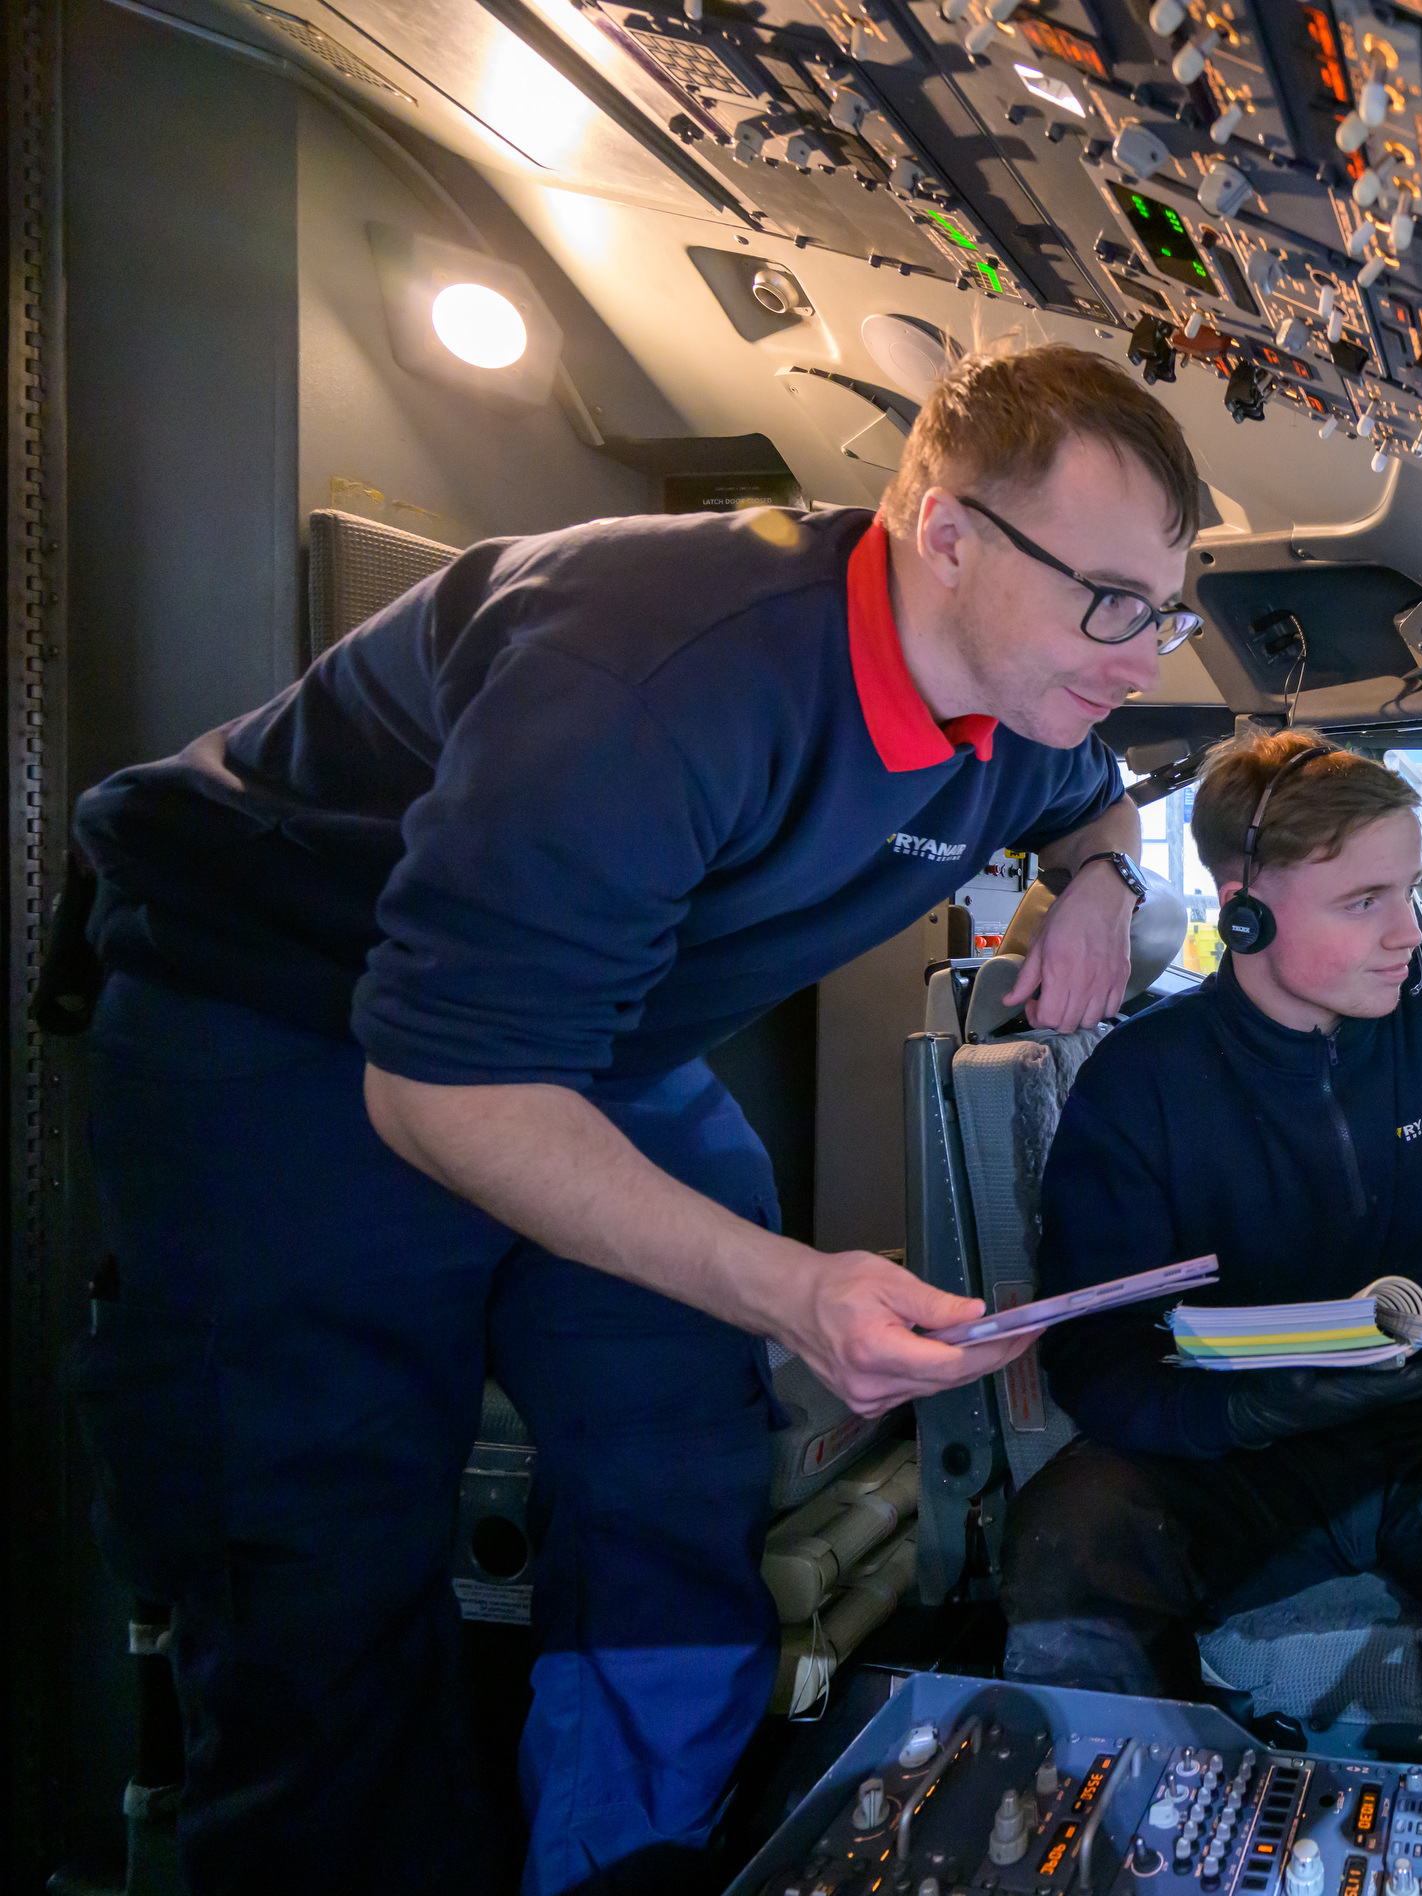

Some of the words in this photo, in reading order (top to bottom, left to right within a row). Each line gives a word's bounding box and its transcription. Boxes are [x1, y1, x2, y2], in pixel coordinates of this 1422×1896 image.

[703, 498, 724, 506] LATCH
[725, 497, 744, 505] DOOR
[746, 497, 772, 505] CLOSED
[895, 832, 967, 856] RYANAIR
